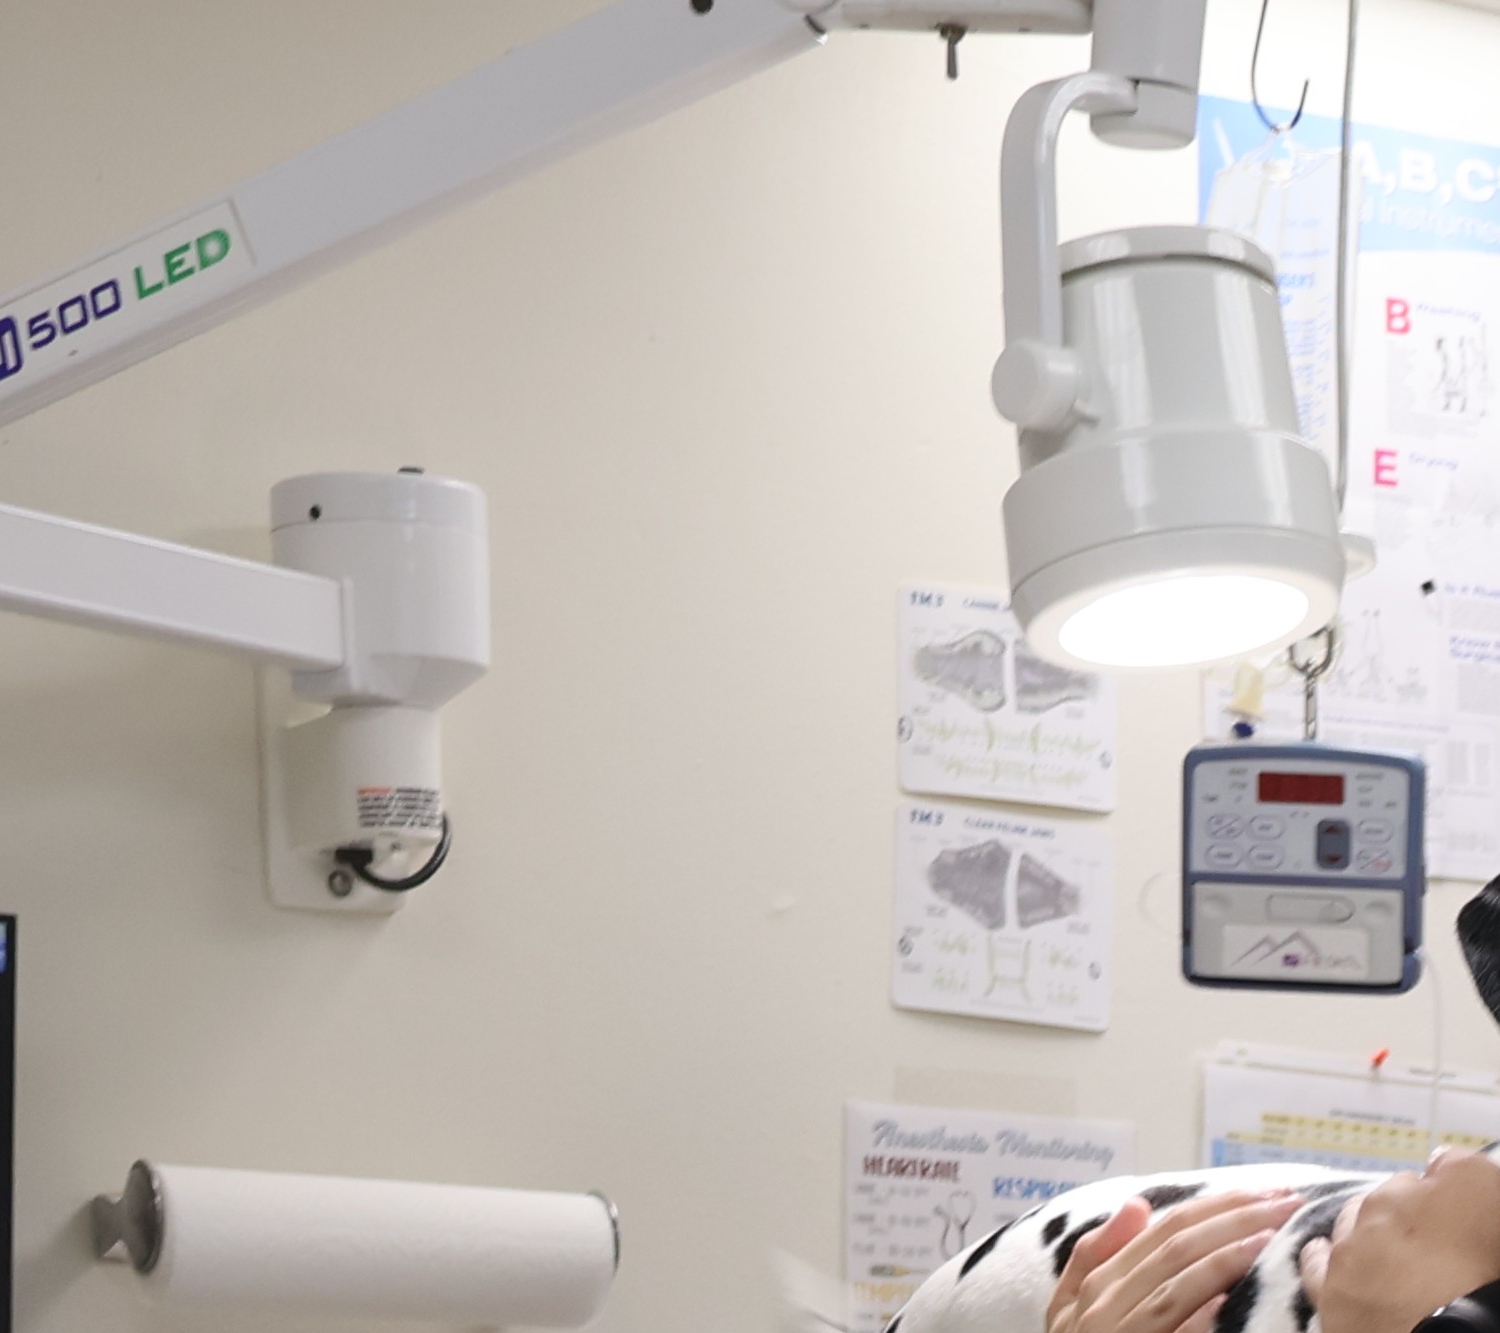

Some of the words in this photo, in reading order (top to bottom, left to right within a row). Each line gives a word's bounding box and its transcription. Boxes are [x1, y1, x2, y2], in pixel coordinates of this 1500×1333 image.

[26, 277, 122, 351] 500
[134, 227, 233, 300] LED
[1384, 296, 1412, 336] B
[1373, 447, 1400, 488] E
